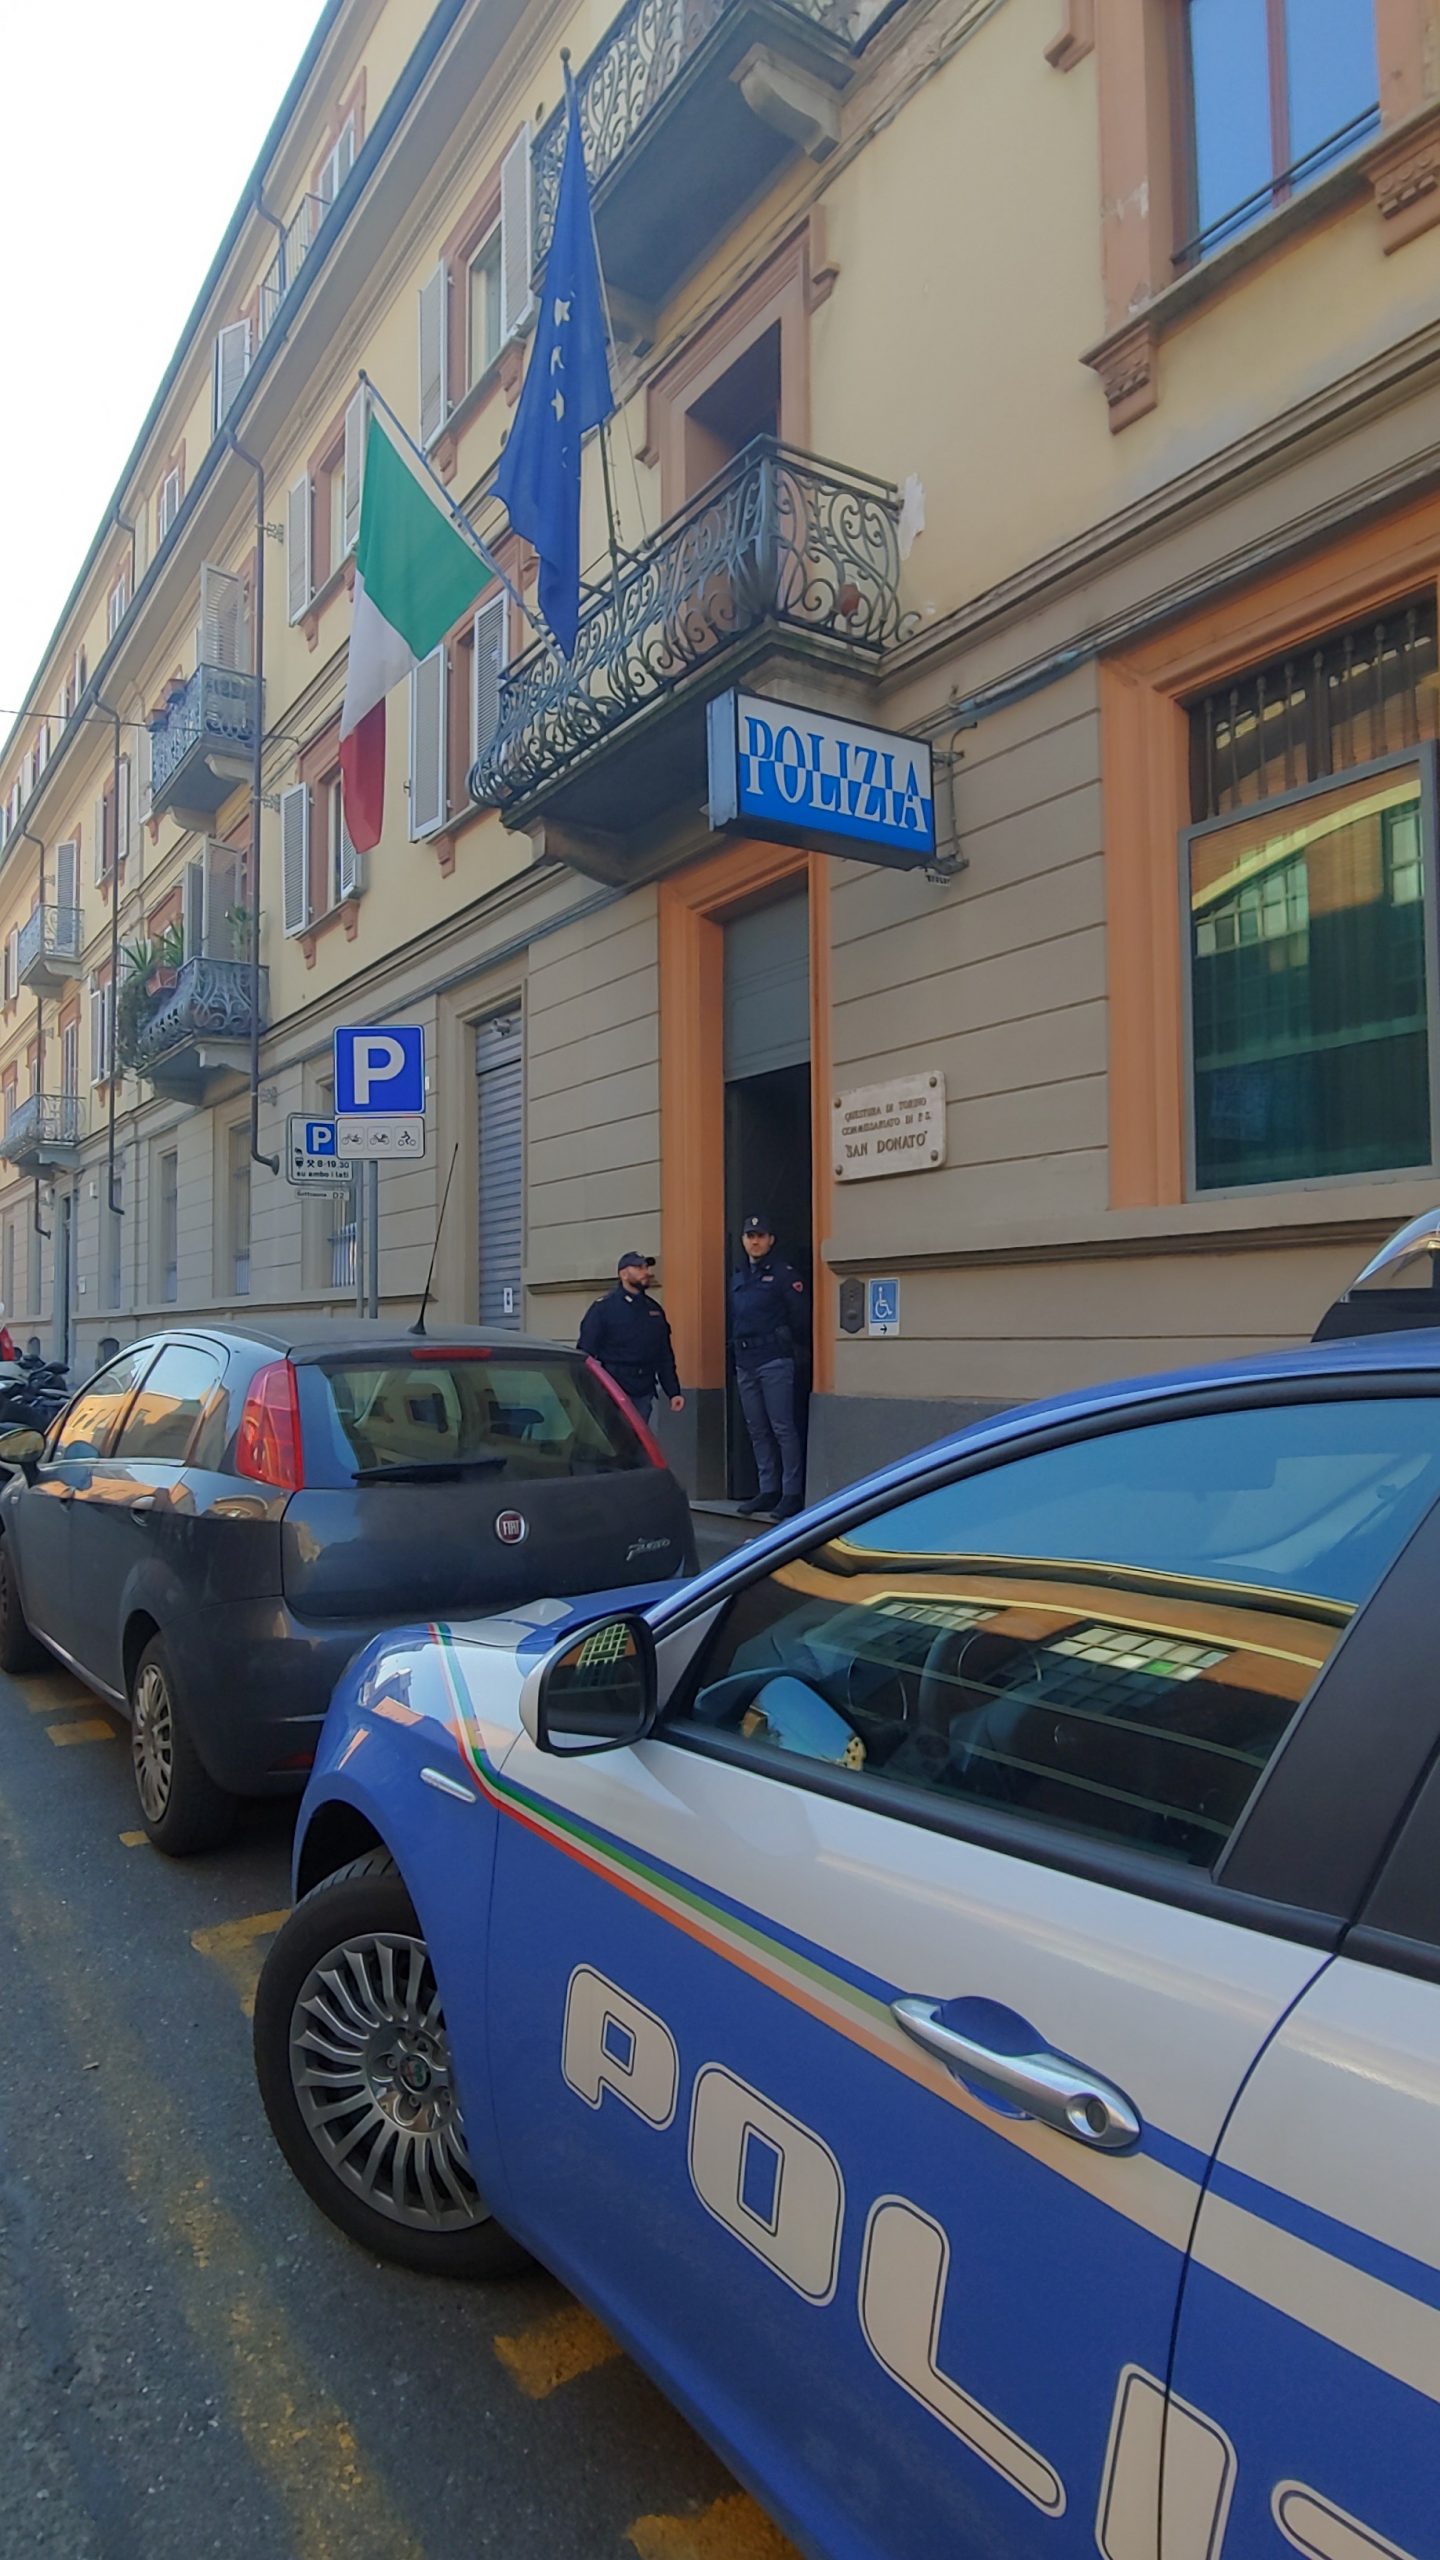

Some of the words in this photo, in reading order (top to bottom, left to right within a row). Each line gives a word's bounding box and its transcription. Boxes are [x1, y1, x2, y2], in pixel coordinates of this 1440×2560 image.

[744, 715, 928, 833] POLIZIA
[353, 1035, 405, 1105] P
[312, 1126, 332, 1151] P
[502, 1519, 520, 1536] FIAT
[561, 1963, 1428, 2560] POLI
